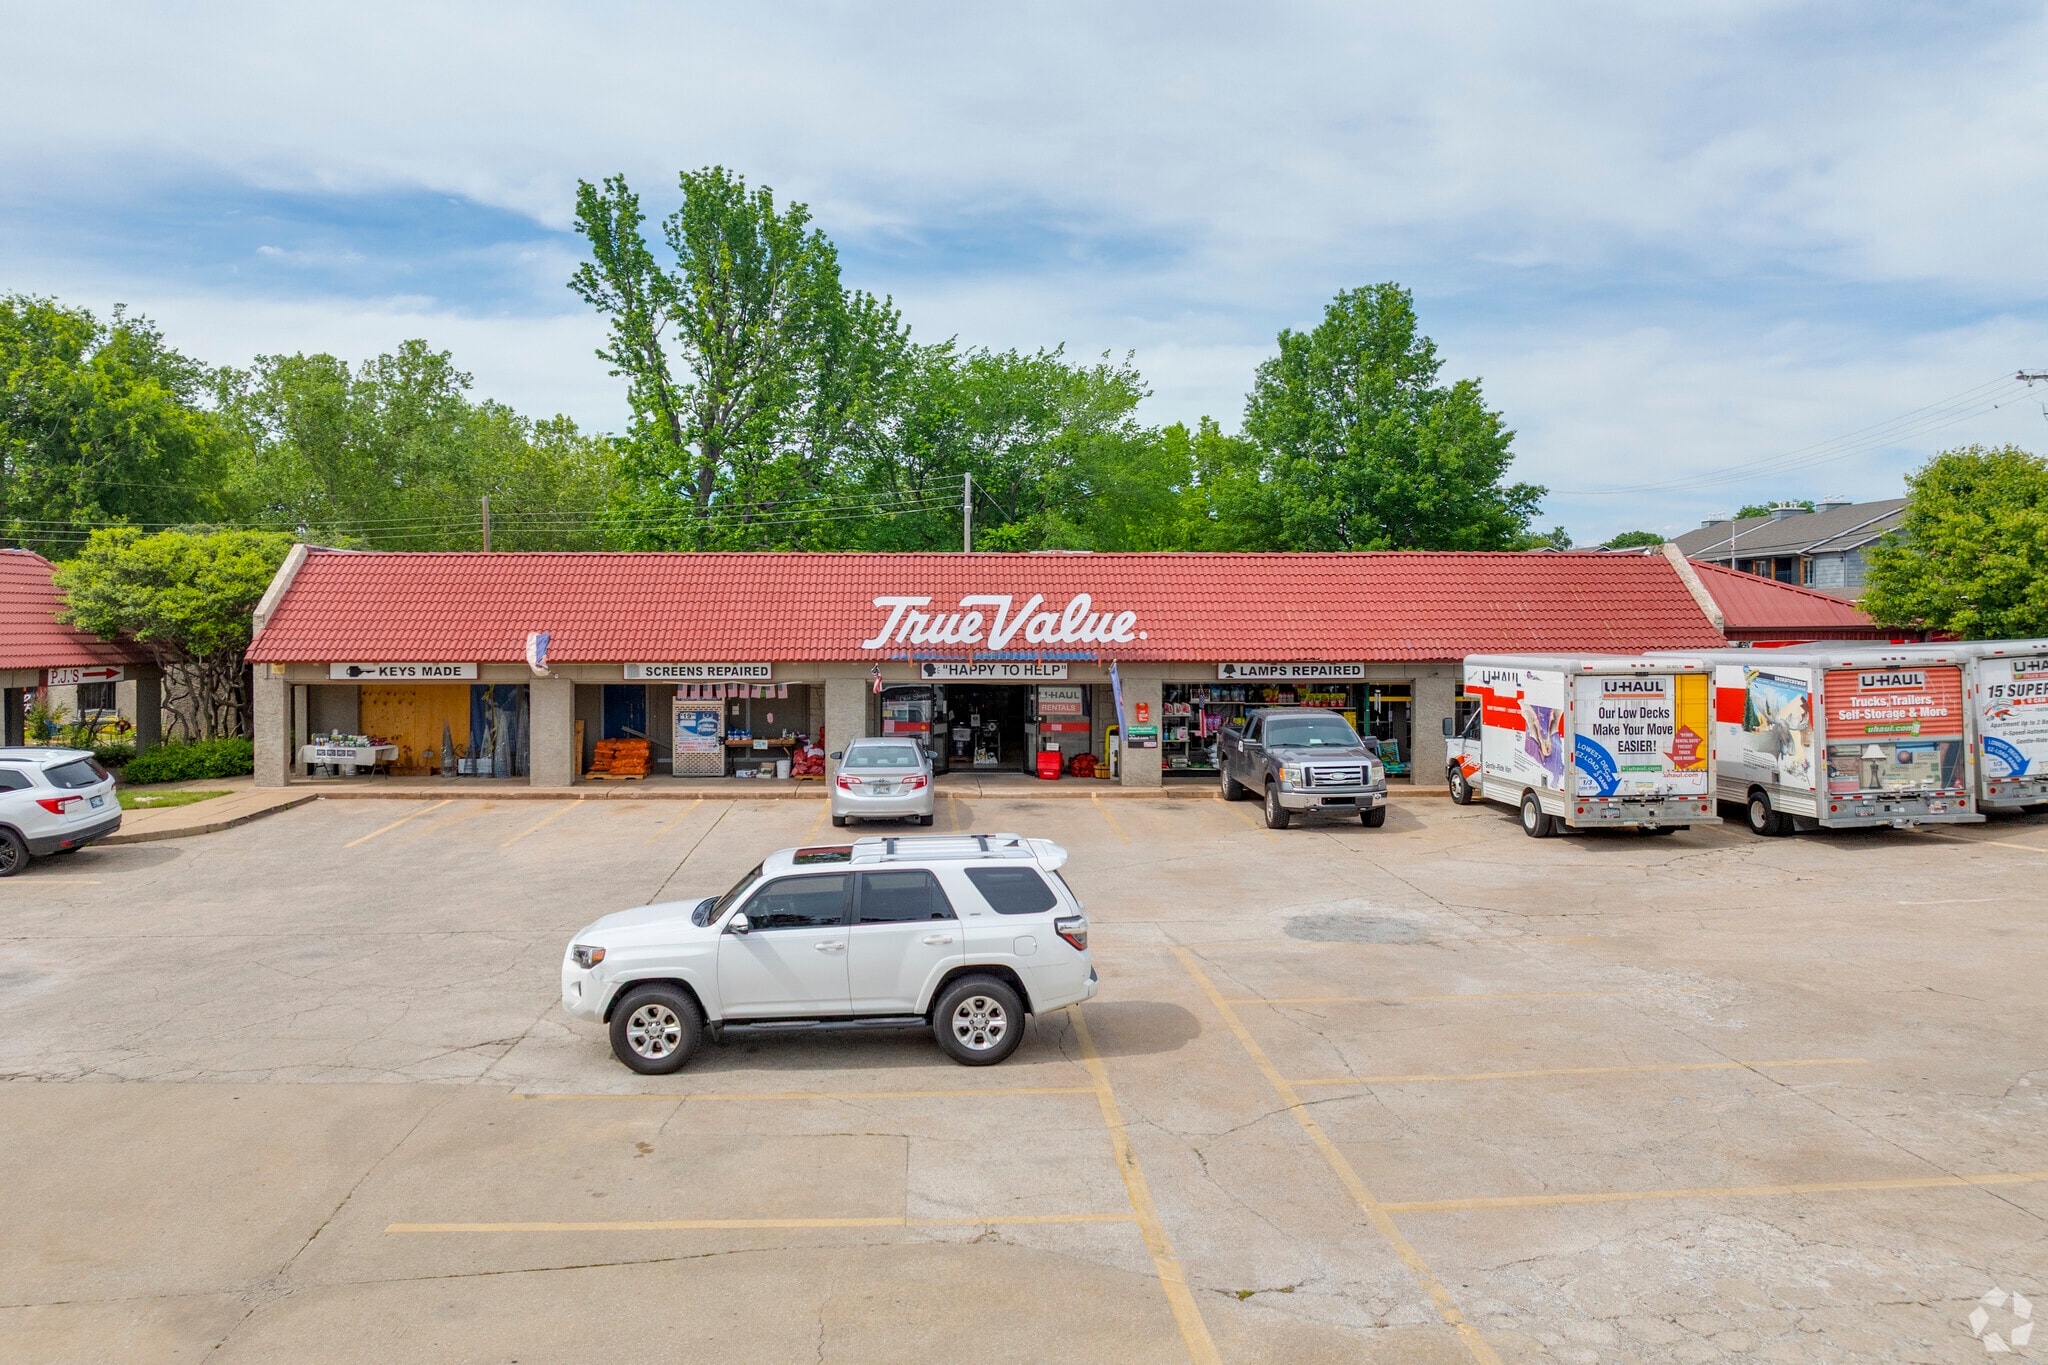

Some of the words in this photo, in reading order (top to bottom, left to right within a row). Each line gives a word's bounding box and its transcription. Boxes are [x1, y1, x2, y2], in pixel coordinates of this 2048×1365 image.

[861, 596, 983, 649] True
[379, 666, 416, 677] KEYS
[422, 666, 462, 677] MADE
[645, 666, 703, 677] SCREENS
[707, 666, 769, 677] REPAIRED
[942, 664, 996, 676] "HAPPY
[1002, 664, 1020, 676] TO
[1024, 664, 1067, 676] HELP"
[1240, 665, 1287, 676] LAMPS
[1292, 665, 1361, 676] REPAIRED
[1482, 670, 1522, 687] U-HAUL
[1861, 674, 1923, 687] U-HAUL
[1604, 681, 1664, 692] U-HAUL
[1850, 696, 1890, 708] Trucks,
[1891, 694, 1935, 706] Trailers,
[1041, 704, 1076, 712] RENTALS
[1598, 707, 1615, 719] Our
[1618, 707, 1637, 719] Low
[1640, 706, 1670, 719] Decks
[1838, 708, 1906, 720] Self-Storage
[1909, 707, 1917, 718] &
[1920, 707, 1948, 717] More
[1593, 723, 1620, 736] Make
[1623, 723, 1645, 736] Your
[1647, 723, 1673, 735] Move
[1577, 742, 1603, 760] LOWEST
[1617, 740, 1657, 753] EASIER!
[1575, 751, 1600, 770] EZ-LOAD
